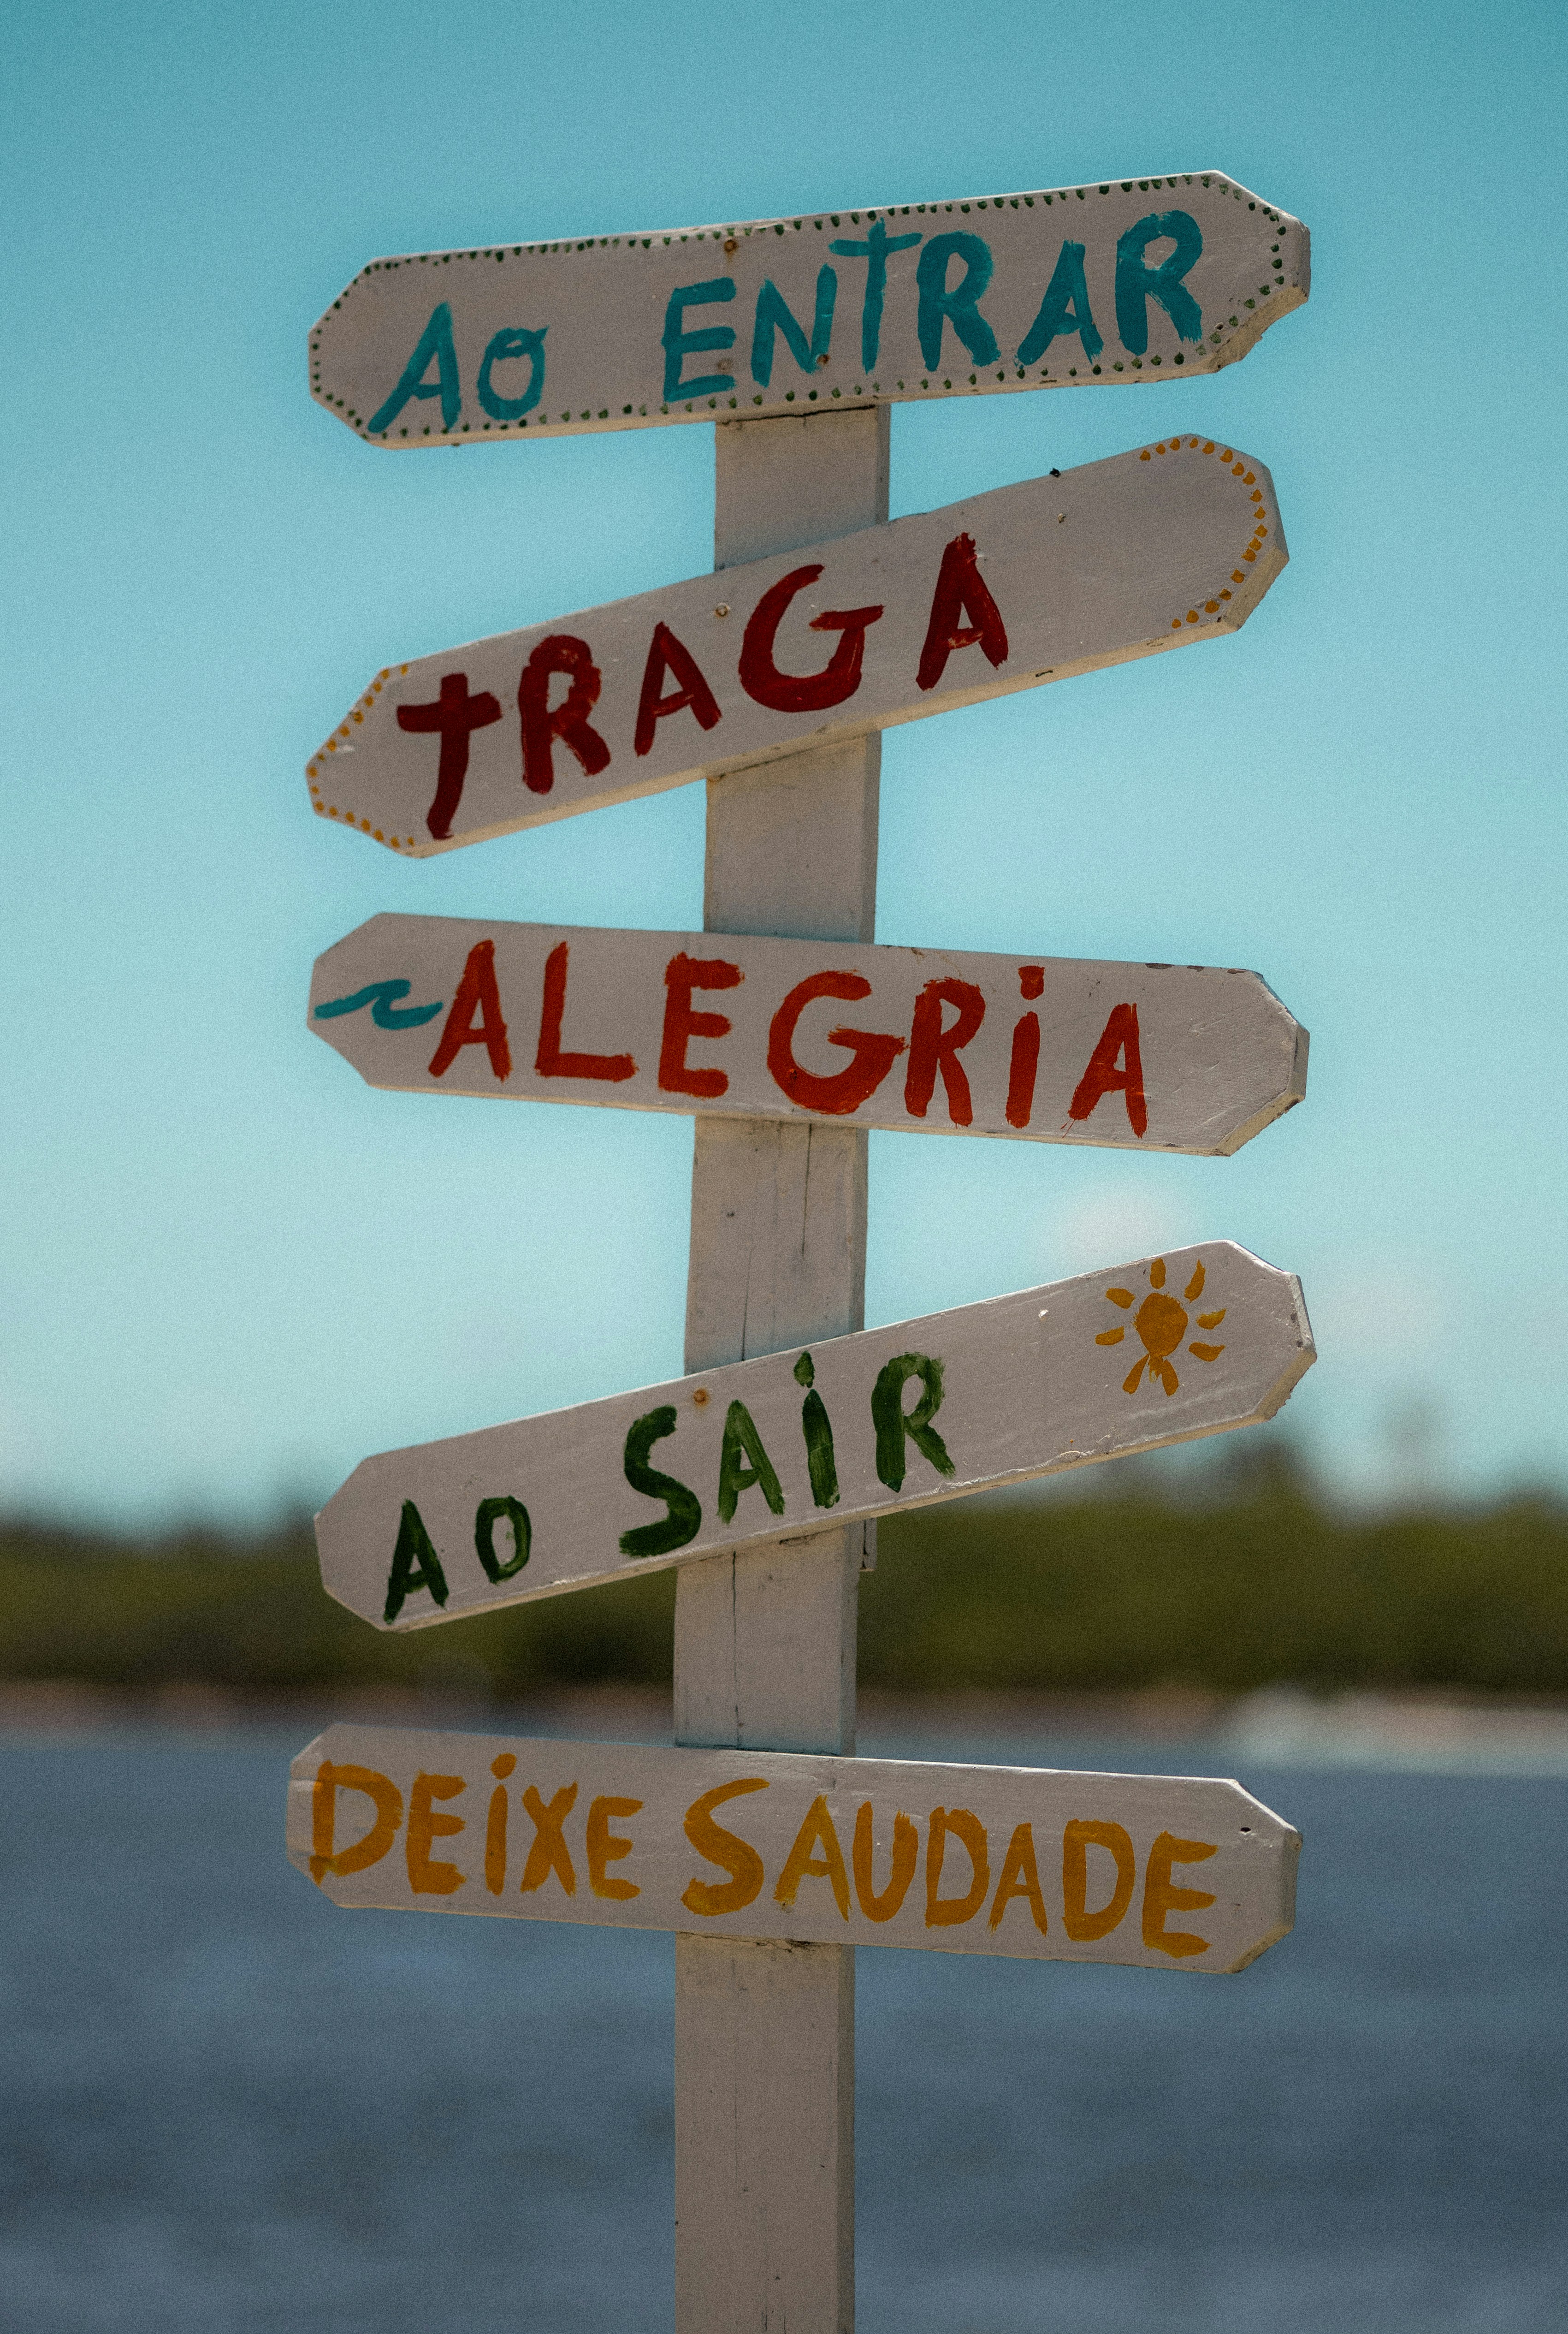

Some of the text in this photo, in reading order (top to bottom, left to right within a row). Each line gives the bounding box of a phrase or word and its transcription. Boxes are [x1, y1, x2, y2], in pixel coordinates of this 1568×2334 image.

[663, 211, 1203, 403] ENTRAR
[384, 1496, 532, 1622] AO
[682, 1777, 1218, 1958] SAUDADE
